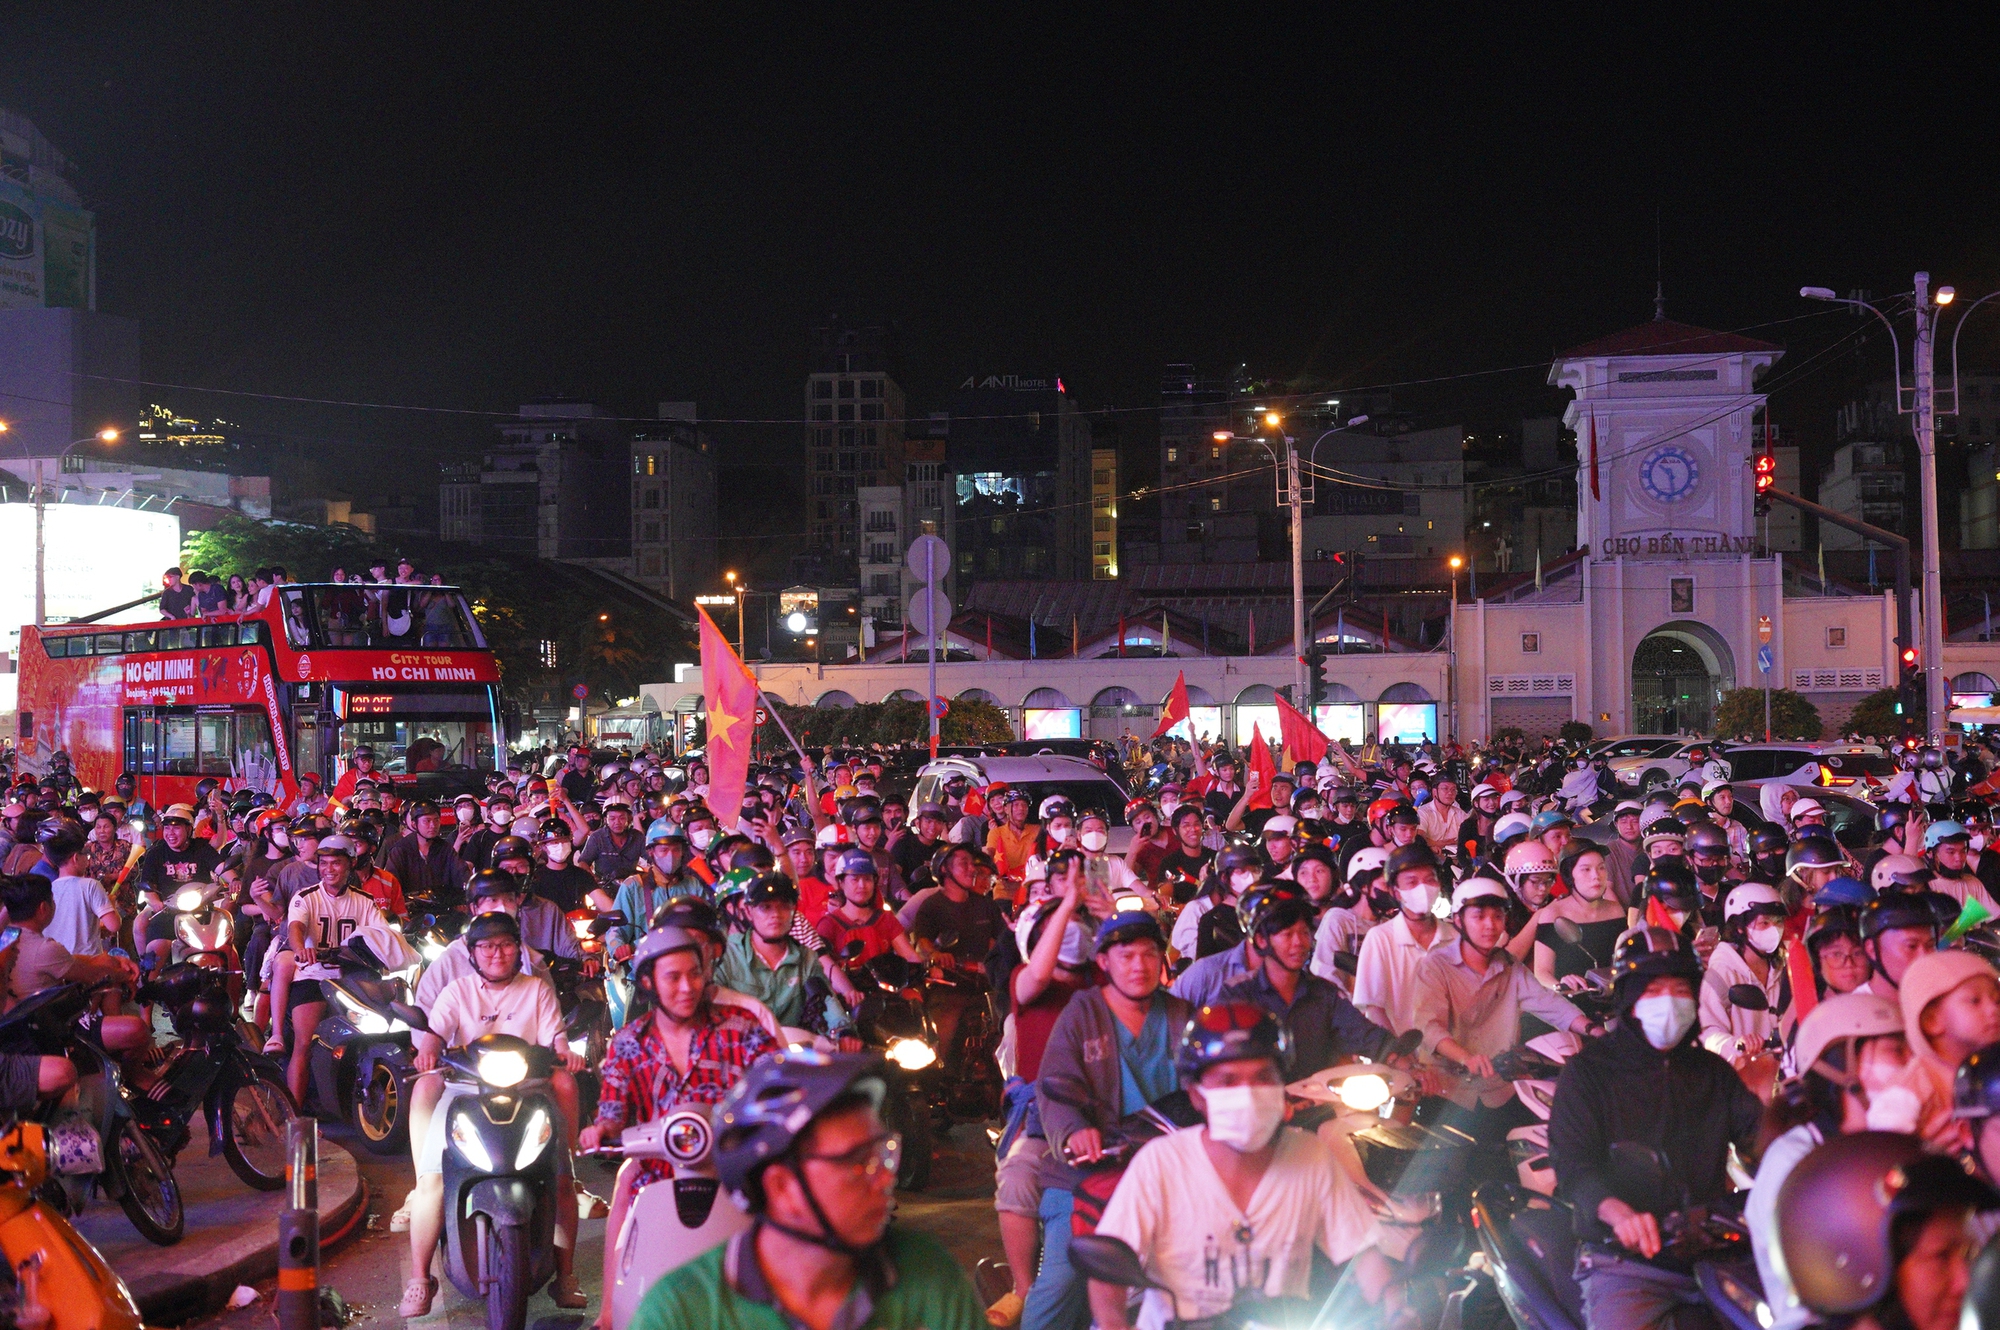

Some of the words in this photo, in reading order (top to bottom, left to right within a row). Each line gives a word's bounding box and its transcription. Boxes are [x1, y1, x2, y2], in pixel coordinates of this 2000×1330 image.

[1020, 379, 1048, 388] HOTEL
[1348, 494, 1388, 505] HALO
[1602, 536, 1641, 556] CHỢ
[1647, 532, 1685, 554] BẾN
[1691, 533, 1758, 554] THÀNH
[390, 653, 420, 665] CITY
[423, 655, 453, 665] TOUR
[126, 662, 142, 683] HO
[143, 660, 162, 682] CHI
[164, 658, 194, 680] MINH
[372, 667, 396, 680] HO
[401, 667, 430, 680] CHI
[434, 667, 476, 681] MINH
[372, 696, 393, 712] OFF
[1457, 768, 1467, 785] 31
[317, 915, 358, 949] 10
